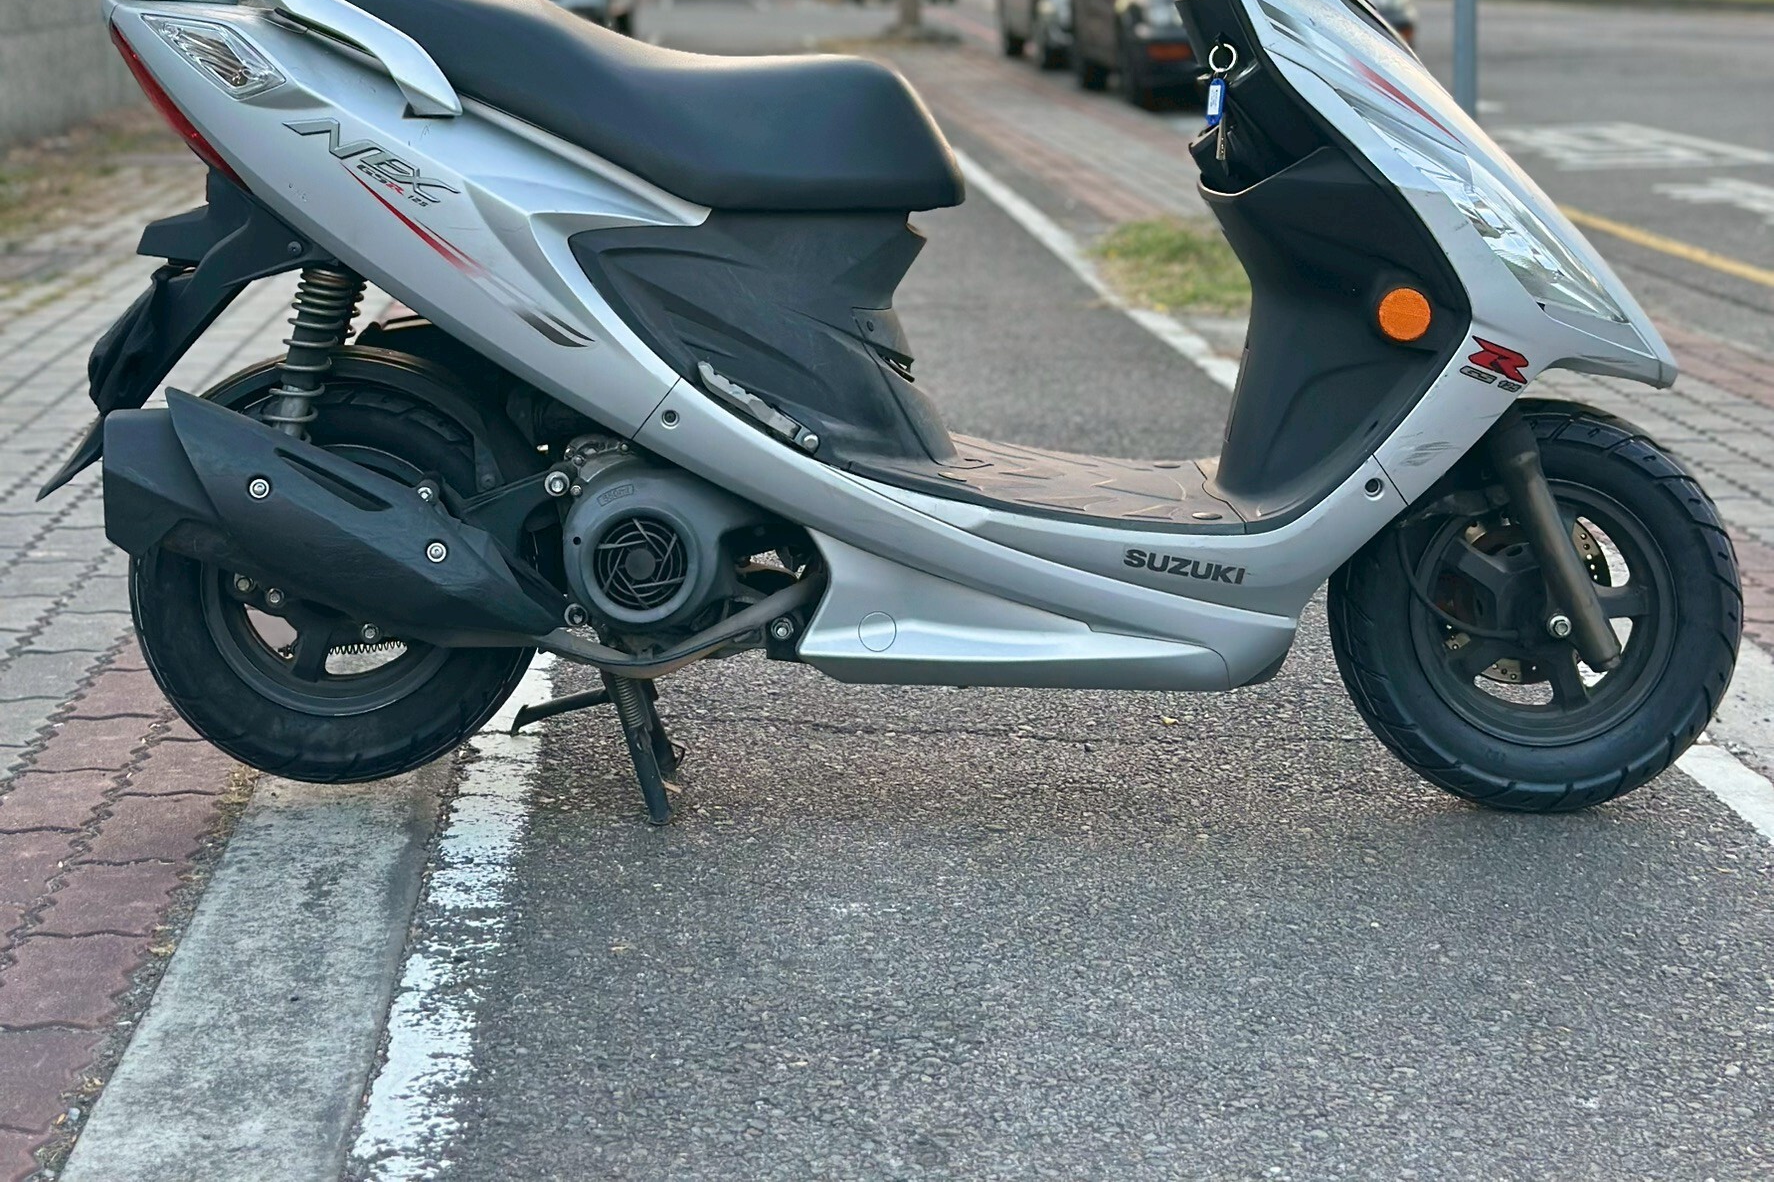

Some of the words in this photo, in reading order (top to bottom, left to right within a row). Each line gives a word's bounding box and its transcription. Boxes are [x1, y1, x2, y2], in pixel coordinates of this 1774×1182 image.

[281, 117, 461, 204] NEX
[407, 194, 429, 207] 125
[1468, 335, 1529, 385] R
[1123, 549, 1246, 585] SUZUKI
